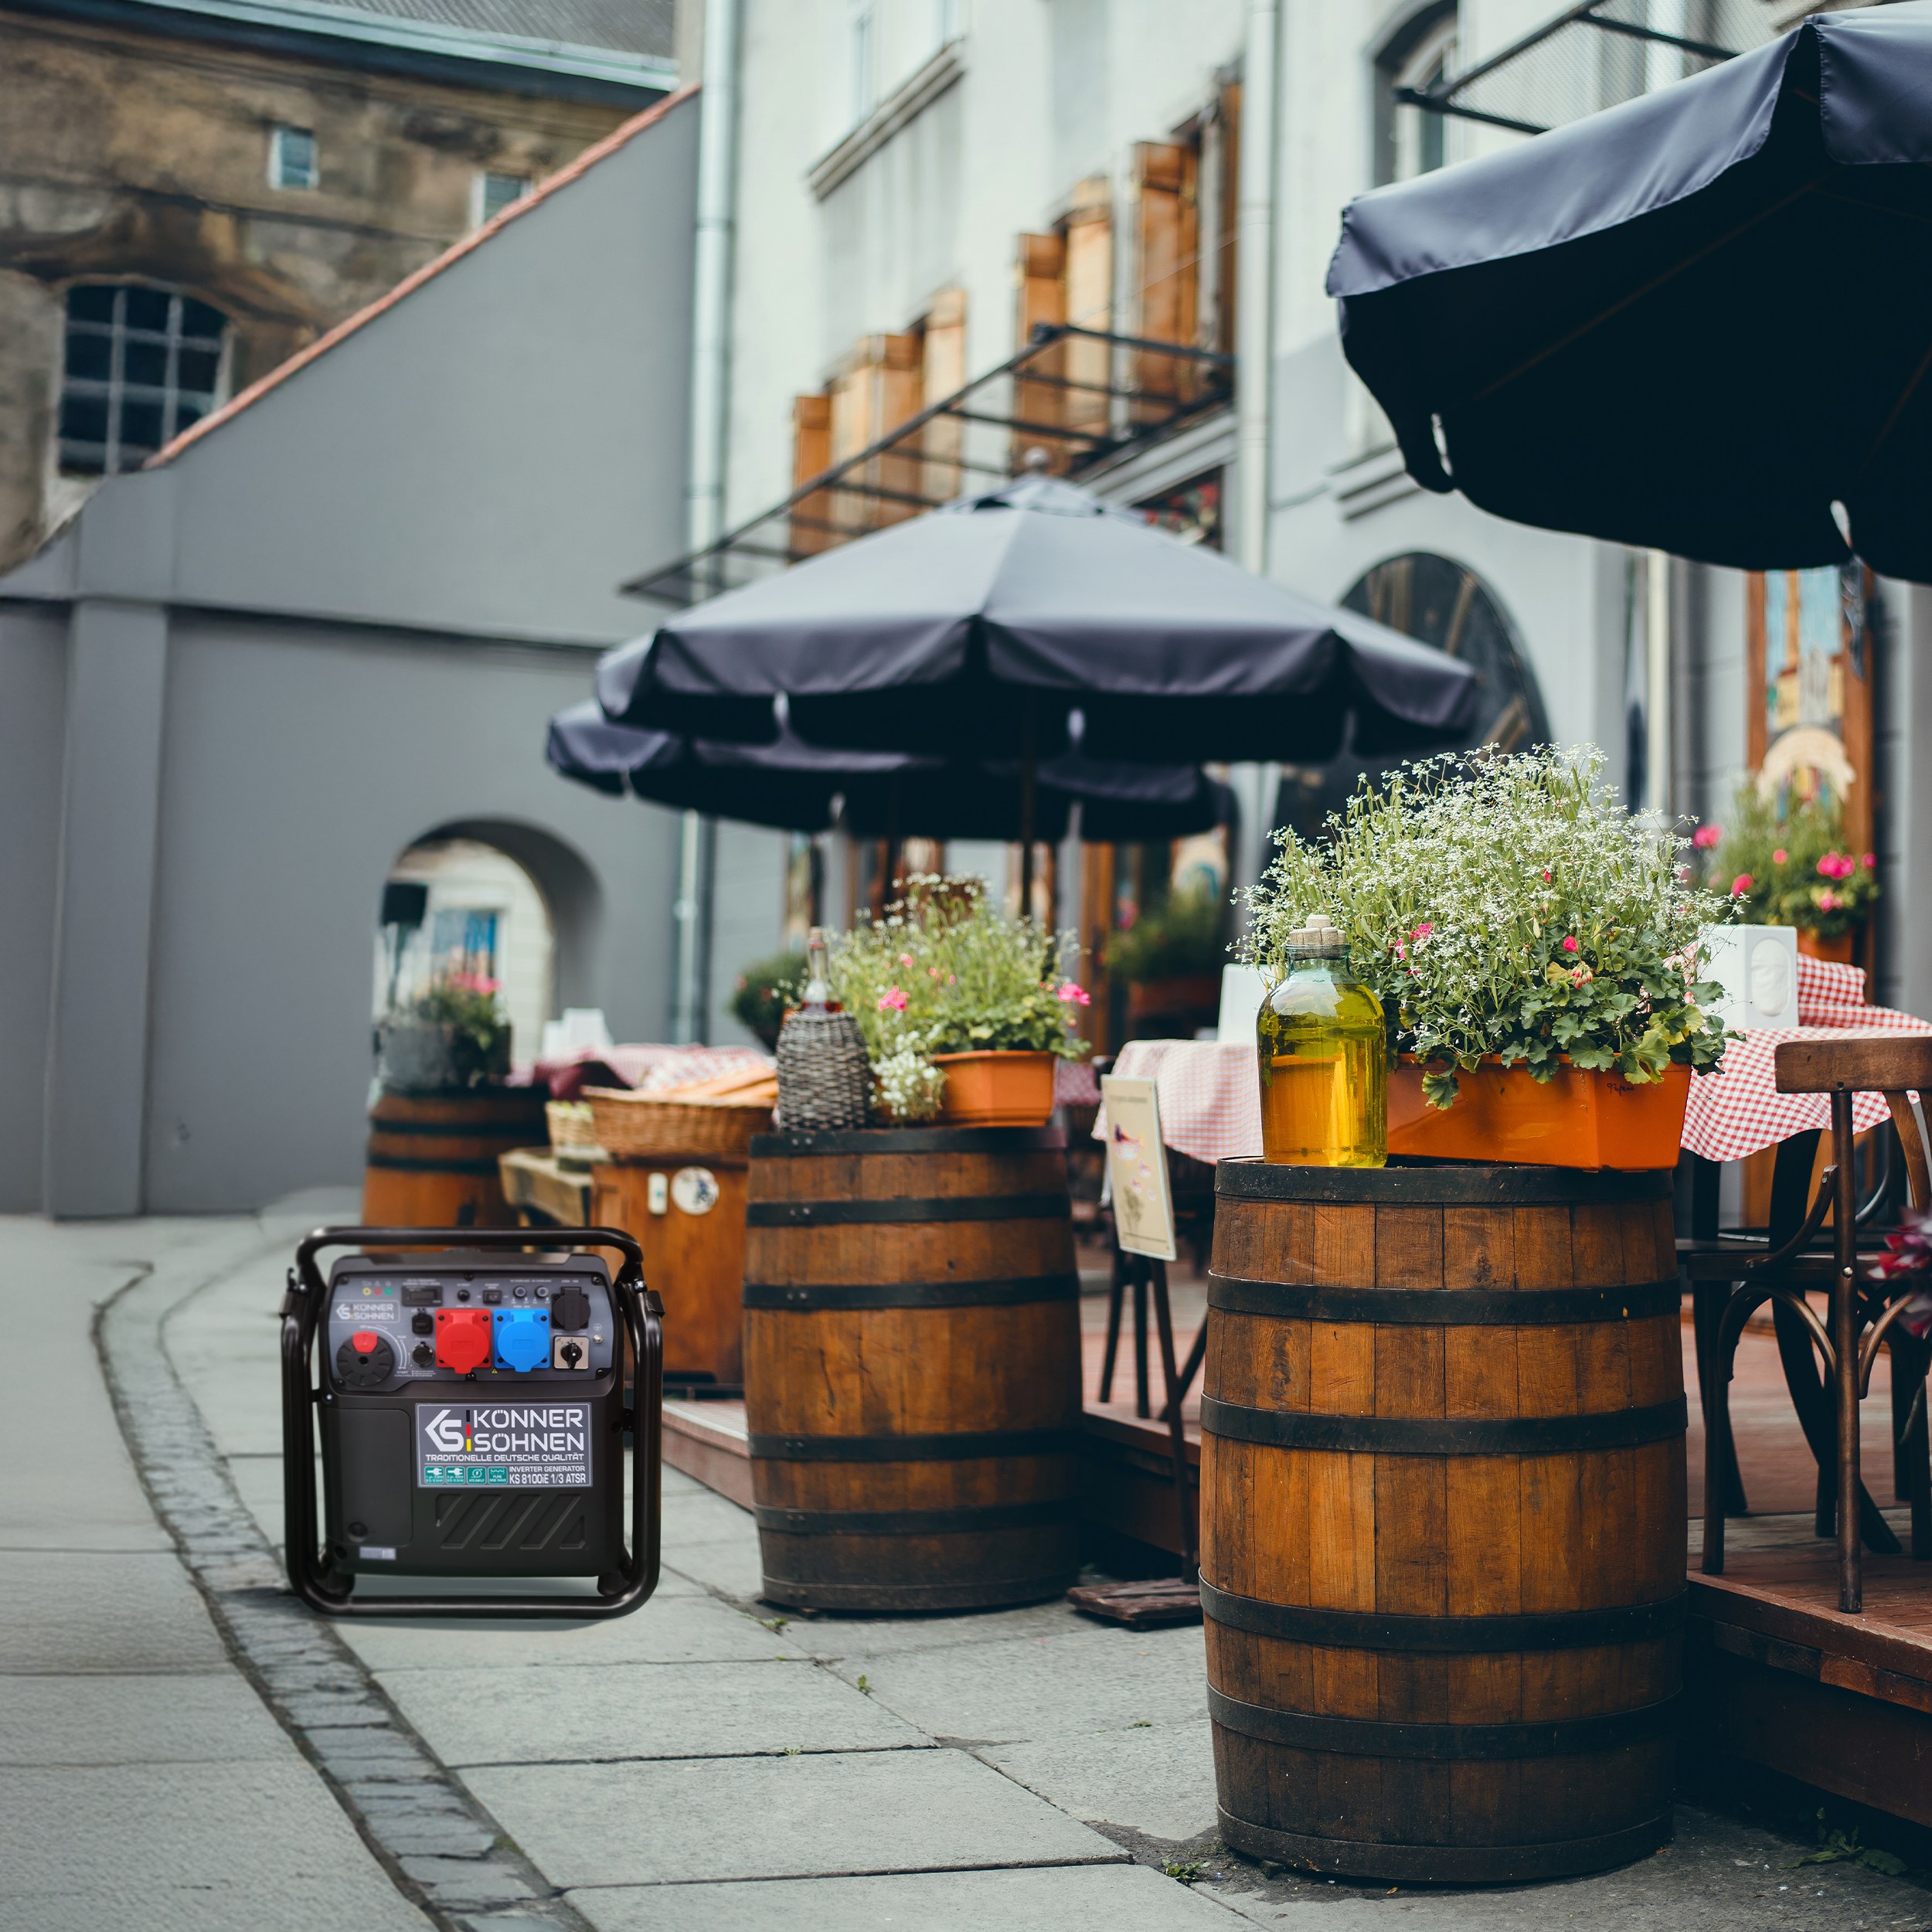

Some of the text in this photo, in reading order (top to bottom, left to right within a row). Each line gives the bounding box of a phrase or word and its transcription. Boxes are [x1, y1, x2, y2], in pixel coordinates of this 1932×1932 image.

[473, 1409, 583, 1429] KÖNNER
[474, 1432, 584, 1452] SÖHNEN
[494, 1454, 539, 1462] DEUTSCHE
[541, 1452, 584, 1462] QUALITÄT
[509, 1473, 586, 1484] KS 8100iE 1/3 ATSR
